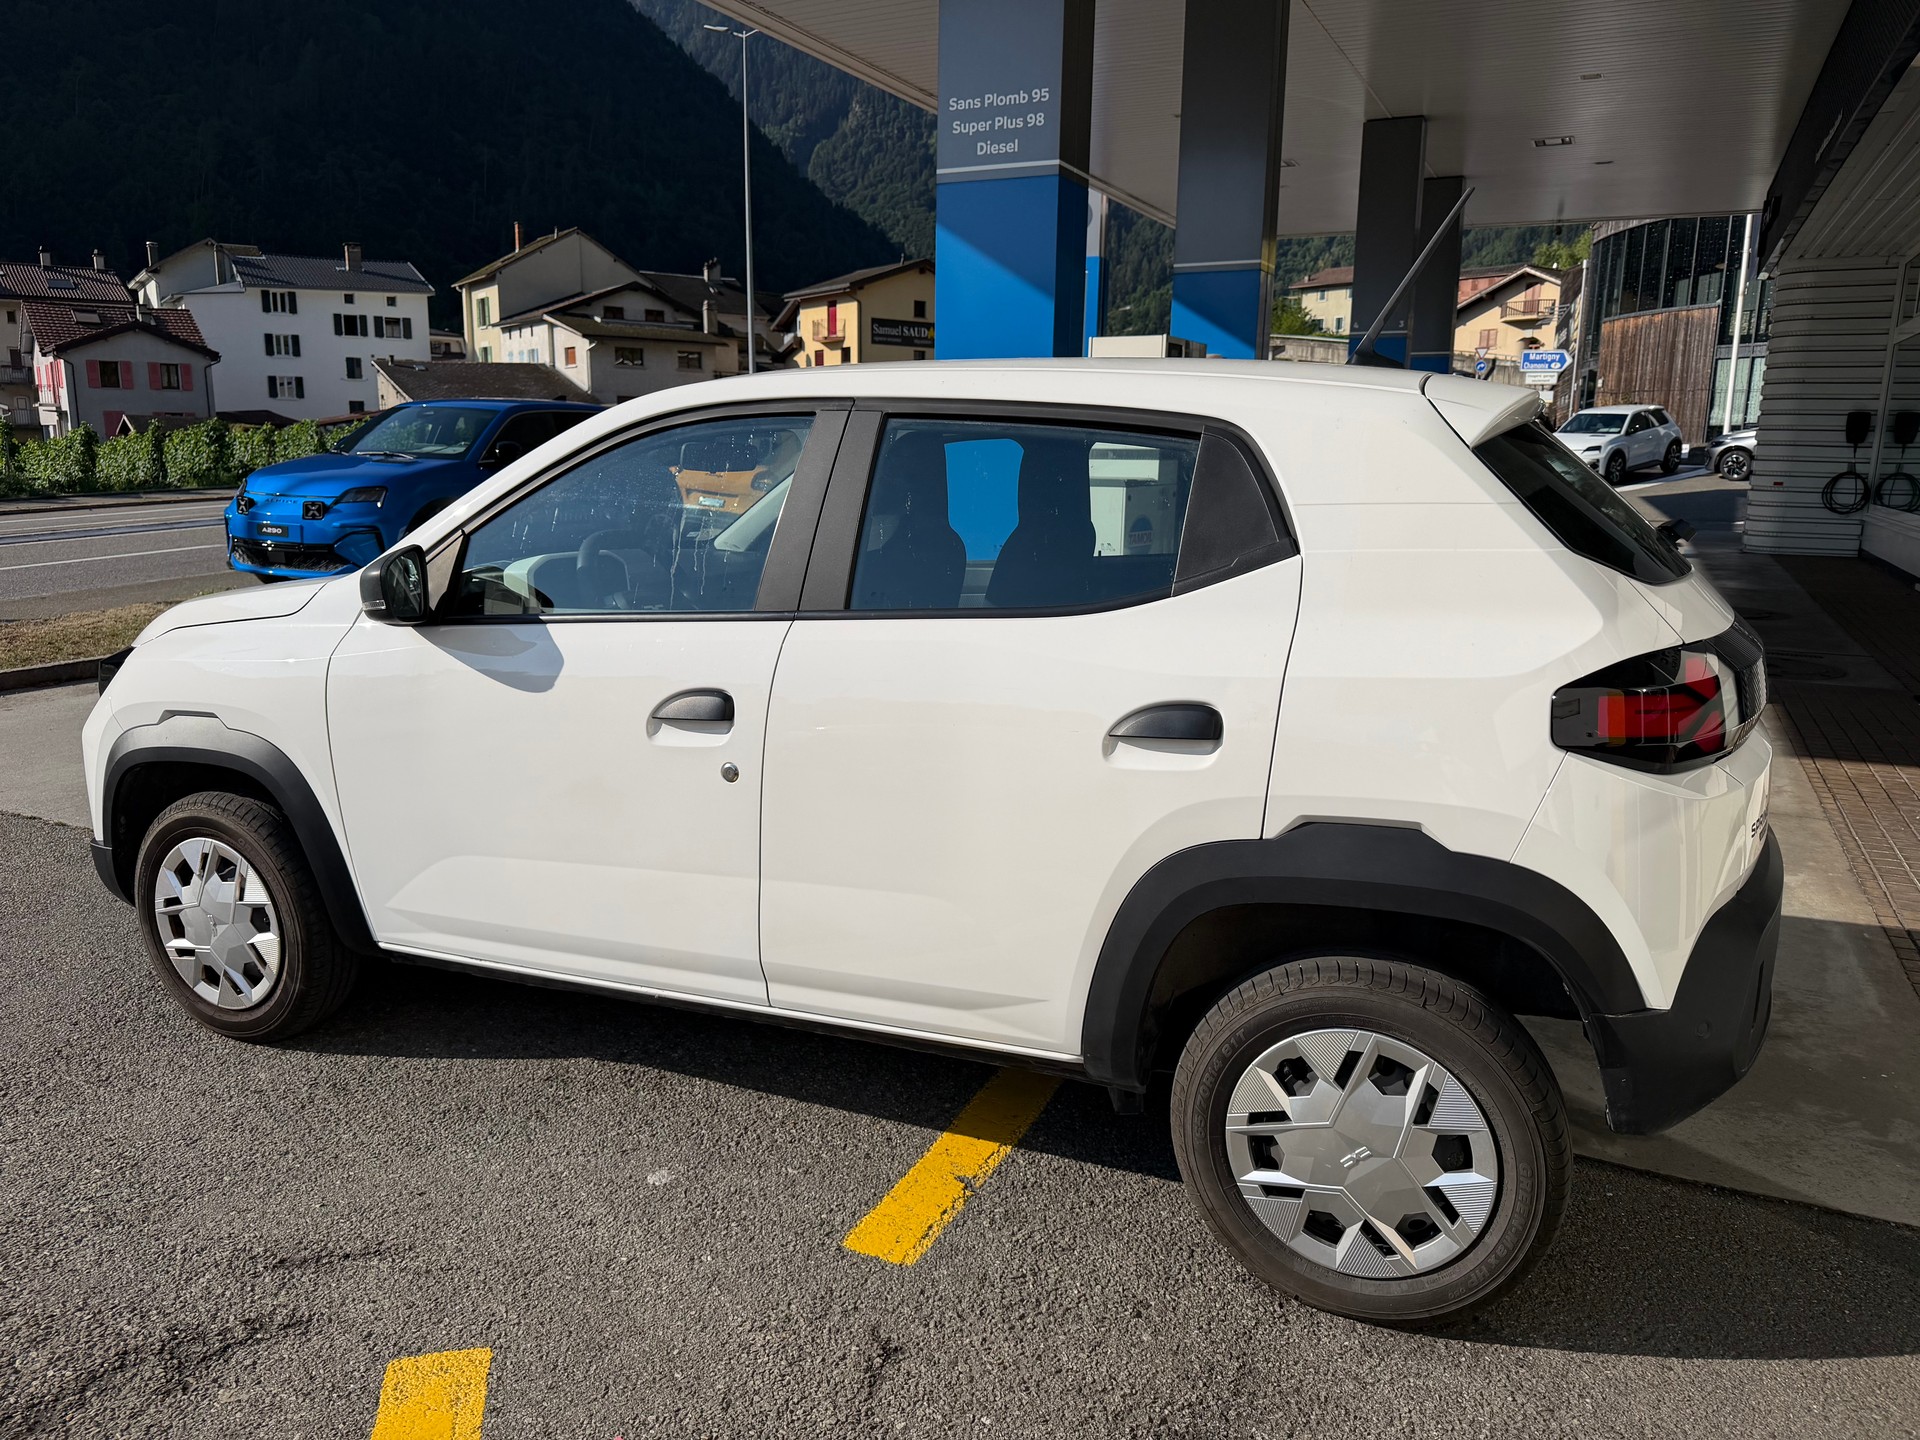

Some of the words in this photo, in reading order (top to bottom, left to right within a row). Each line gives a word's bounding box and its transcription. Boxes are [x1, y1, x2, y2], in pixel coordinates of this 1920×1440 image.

[948, 97, 981, 111] Sans
[984, 90, 1029, 108] Plomb
[1031, 87, 1050, 103] 95
[952, 120, 992, 136] Super
[994, 115, 1024, 131] Plus
[1026, 112, 1045, 127] 98
[976, 138, 1019, 156] Diesel
[872, 323, 902, 336] Samuel
[1398, 320, 1405, 328] 3
[1529, 353, 1560, 361] Martigny
